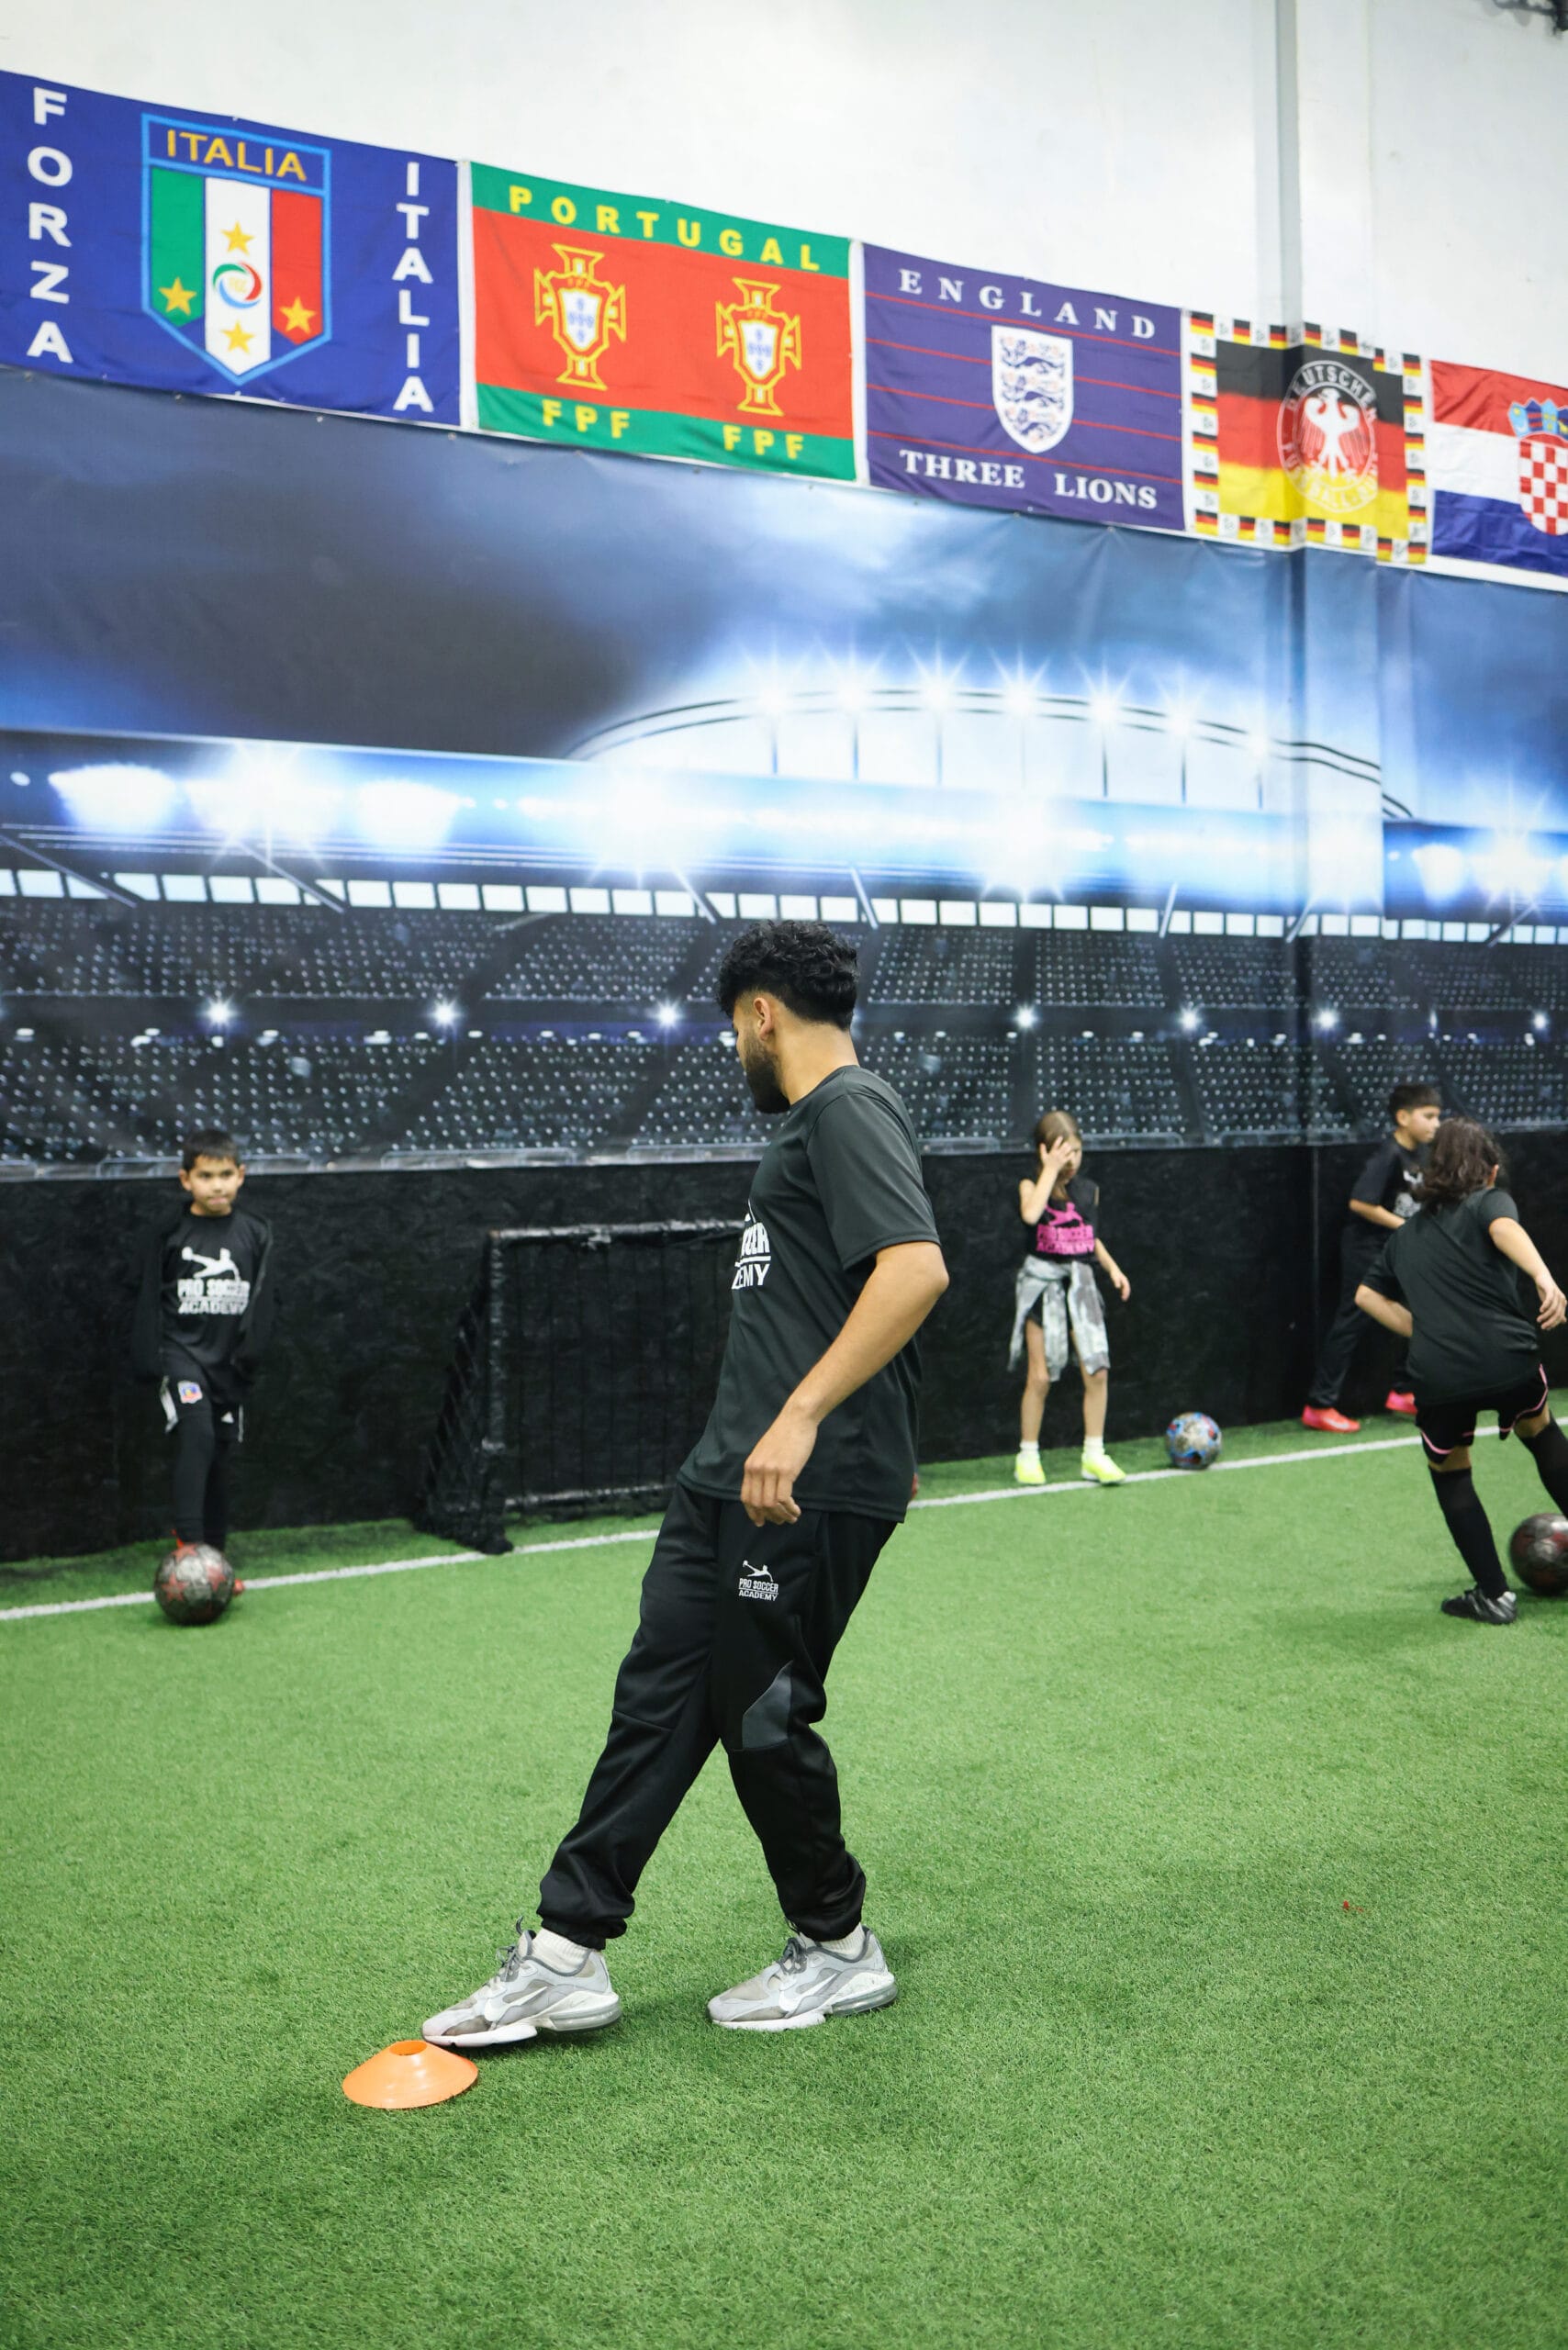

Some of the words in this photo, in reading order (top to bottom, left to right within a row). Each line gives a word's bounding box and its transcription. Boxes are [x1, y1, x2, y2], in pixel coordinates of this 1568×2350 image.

[166, 129, 308, 182] ITALIA
[27, 87, 73, 364] FORZA
[509, 185, 820, 272] PORTUGAL
[391, 162, 433, 413] ITALIA
[898, 268, 1156, 340] ENGLAND
[541, 399, 630, 438] FPF
[722, 424, 804, 460] FPF
[899, 449, 1025, 489] THREE
[1054, 473, 1158, 509] LIONS
[739, 1578, 752, 1589] PRO
[753, 1580, 778, 1593] SOCCER
[739, 1590, 778, 1601] ACADEMY
